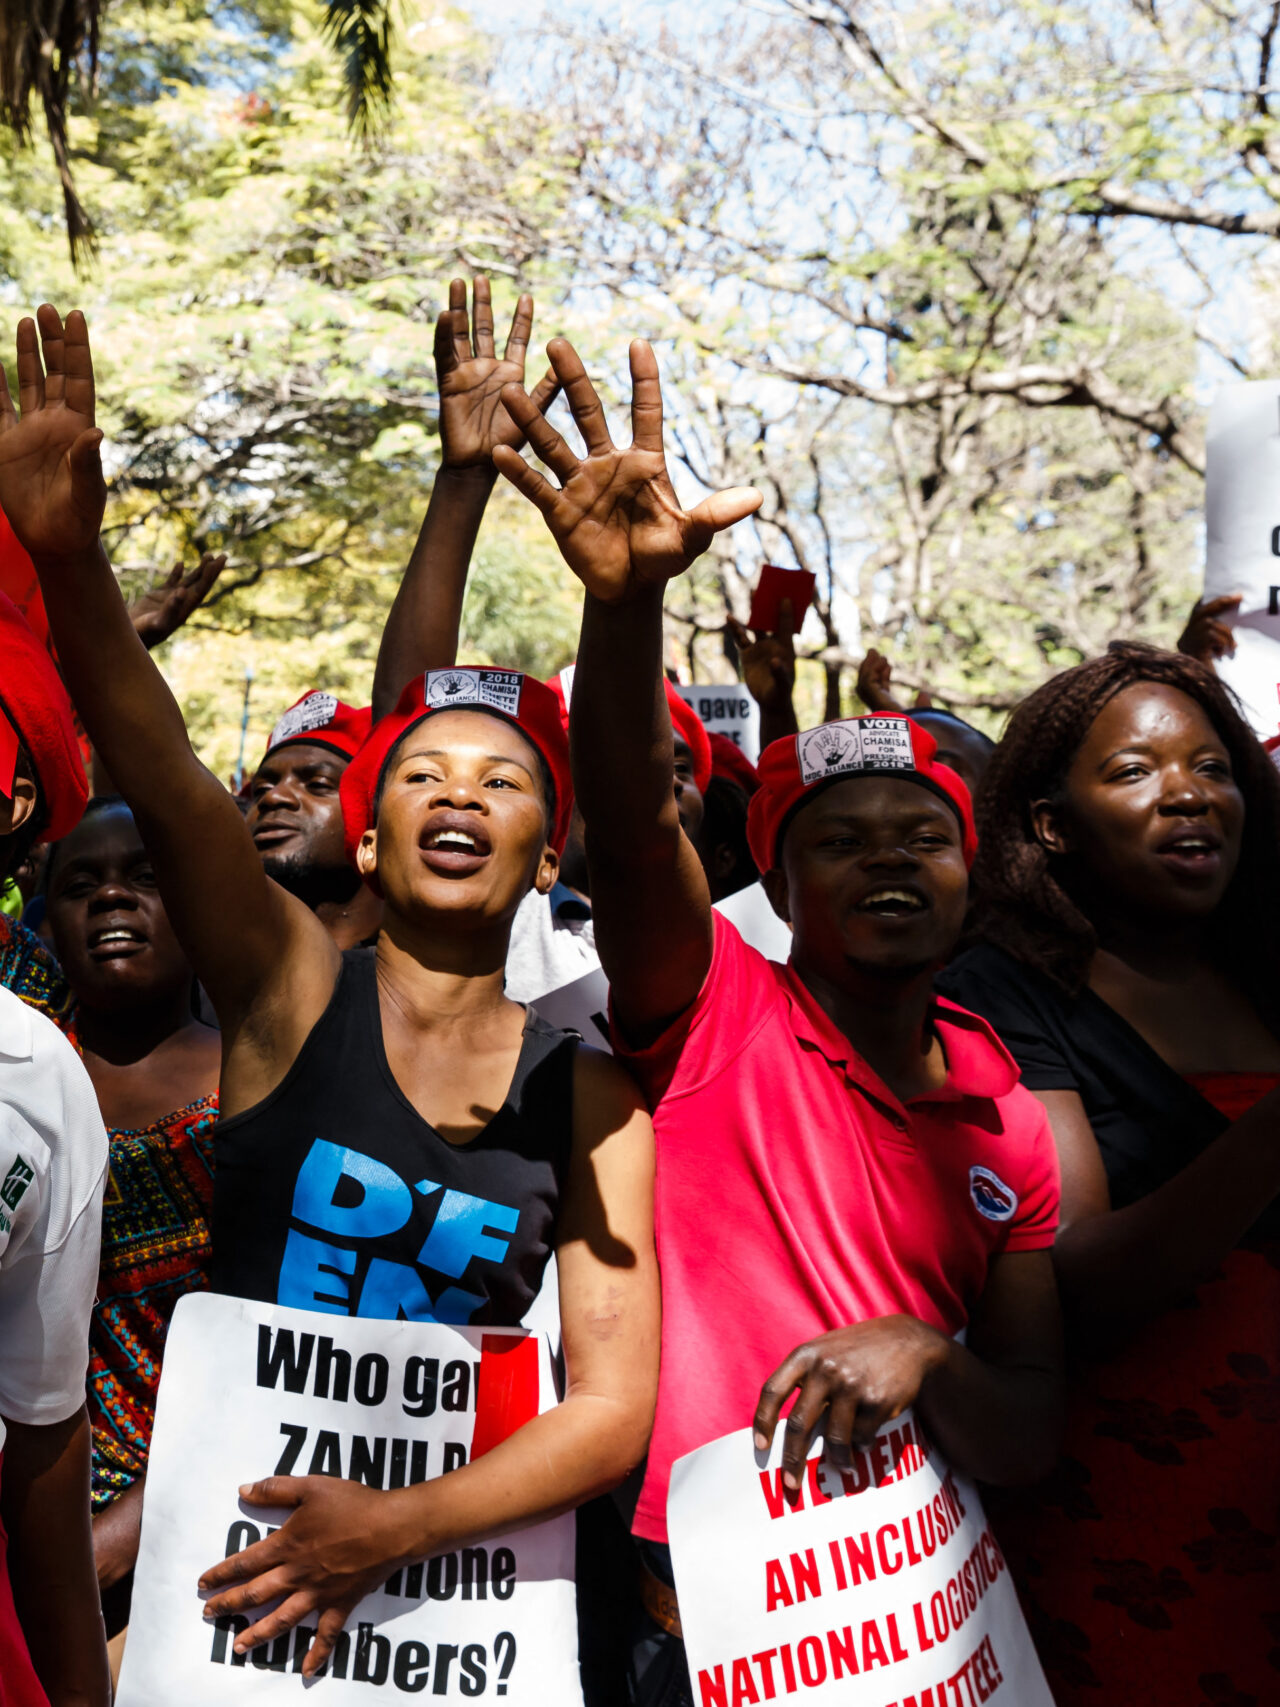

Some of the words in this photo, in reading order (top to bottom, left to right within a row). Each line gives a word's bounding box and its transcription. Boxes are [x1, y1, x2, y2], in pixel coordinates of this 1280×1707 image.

[481, 683, 517, 695] CHAMISA
[486, 673, 518, 684] 2018
[698, 698, 750, 722] gave
[863, 719, 907, 729] VOTE
[863, 737, 907, 747] CHAMISA
[864, 754, 910, 762] PRESIDENT
[804, 771, 822, 780] MDC
[824, 761, 863, 775] ALLIANCE
[256, 1324, 389, 1406] Who
[402, 1355, 481, 1418] ga
[759, 1453, 832, 1519] WE
[765, 1548, 822, 1613] AN
[828, 1469, 966, 1591] INCLUSIVE
[384, 1547, 517, 1601] one
[210, 1612, 517, 1697] numbers?
[697, 1612, 909, 1707] NATIONAL
